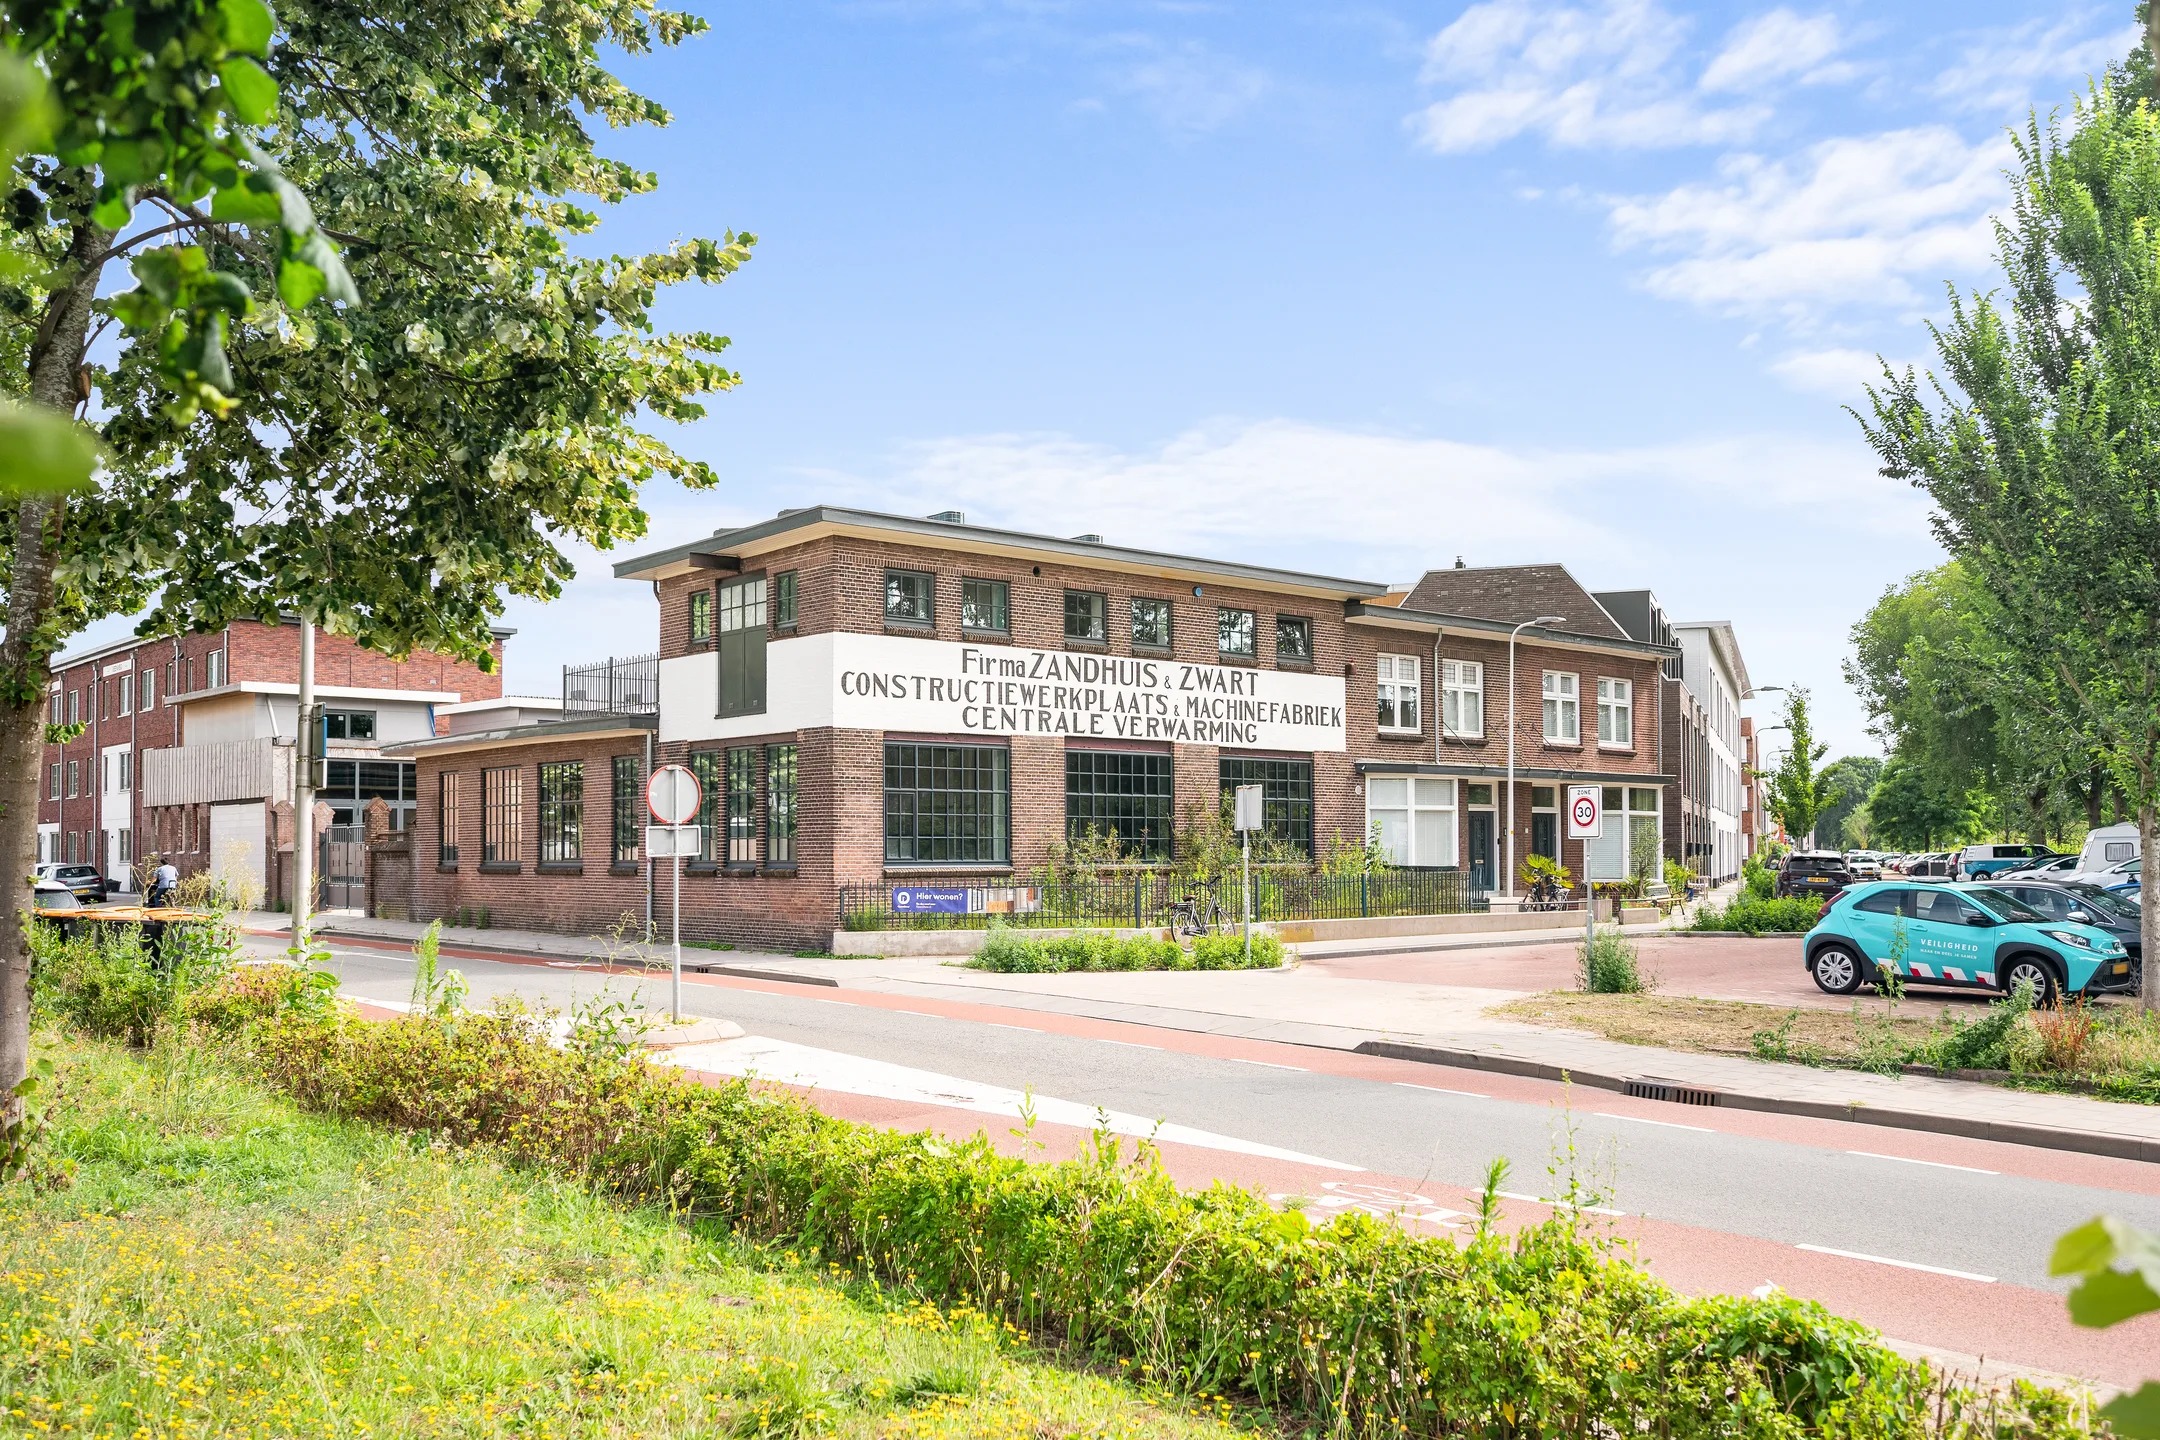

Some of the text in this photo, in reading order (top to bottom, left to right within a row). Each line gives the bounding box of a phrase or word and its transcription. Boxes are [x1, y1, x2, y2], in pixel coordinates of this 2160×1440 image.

[962, 648, 1259, 696] Firma ZANDHUIS & ZWART
[841, 671, 1342, 727] CONSTRUCTIEWERKPLAATS & MACHINEFABRIEK
[962, 706, 1258, 743] CENTRALE VERWARMING
[1577, 806, 1592, 818] 30
[916, 892, 964, 901] Hier wonen?
[1920, 938, 1978, 952] VEILIGHEID
